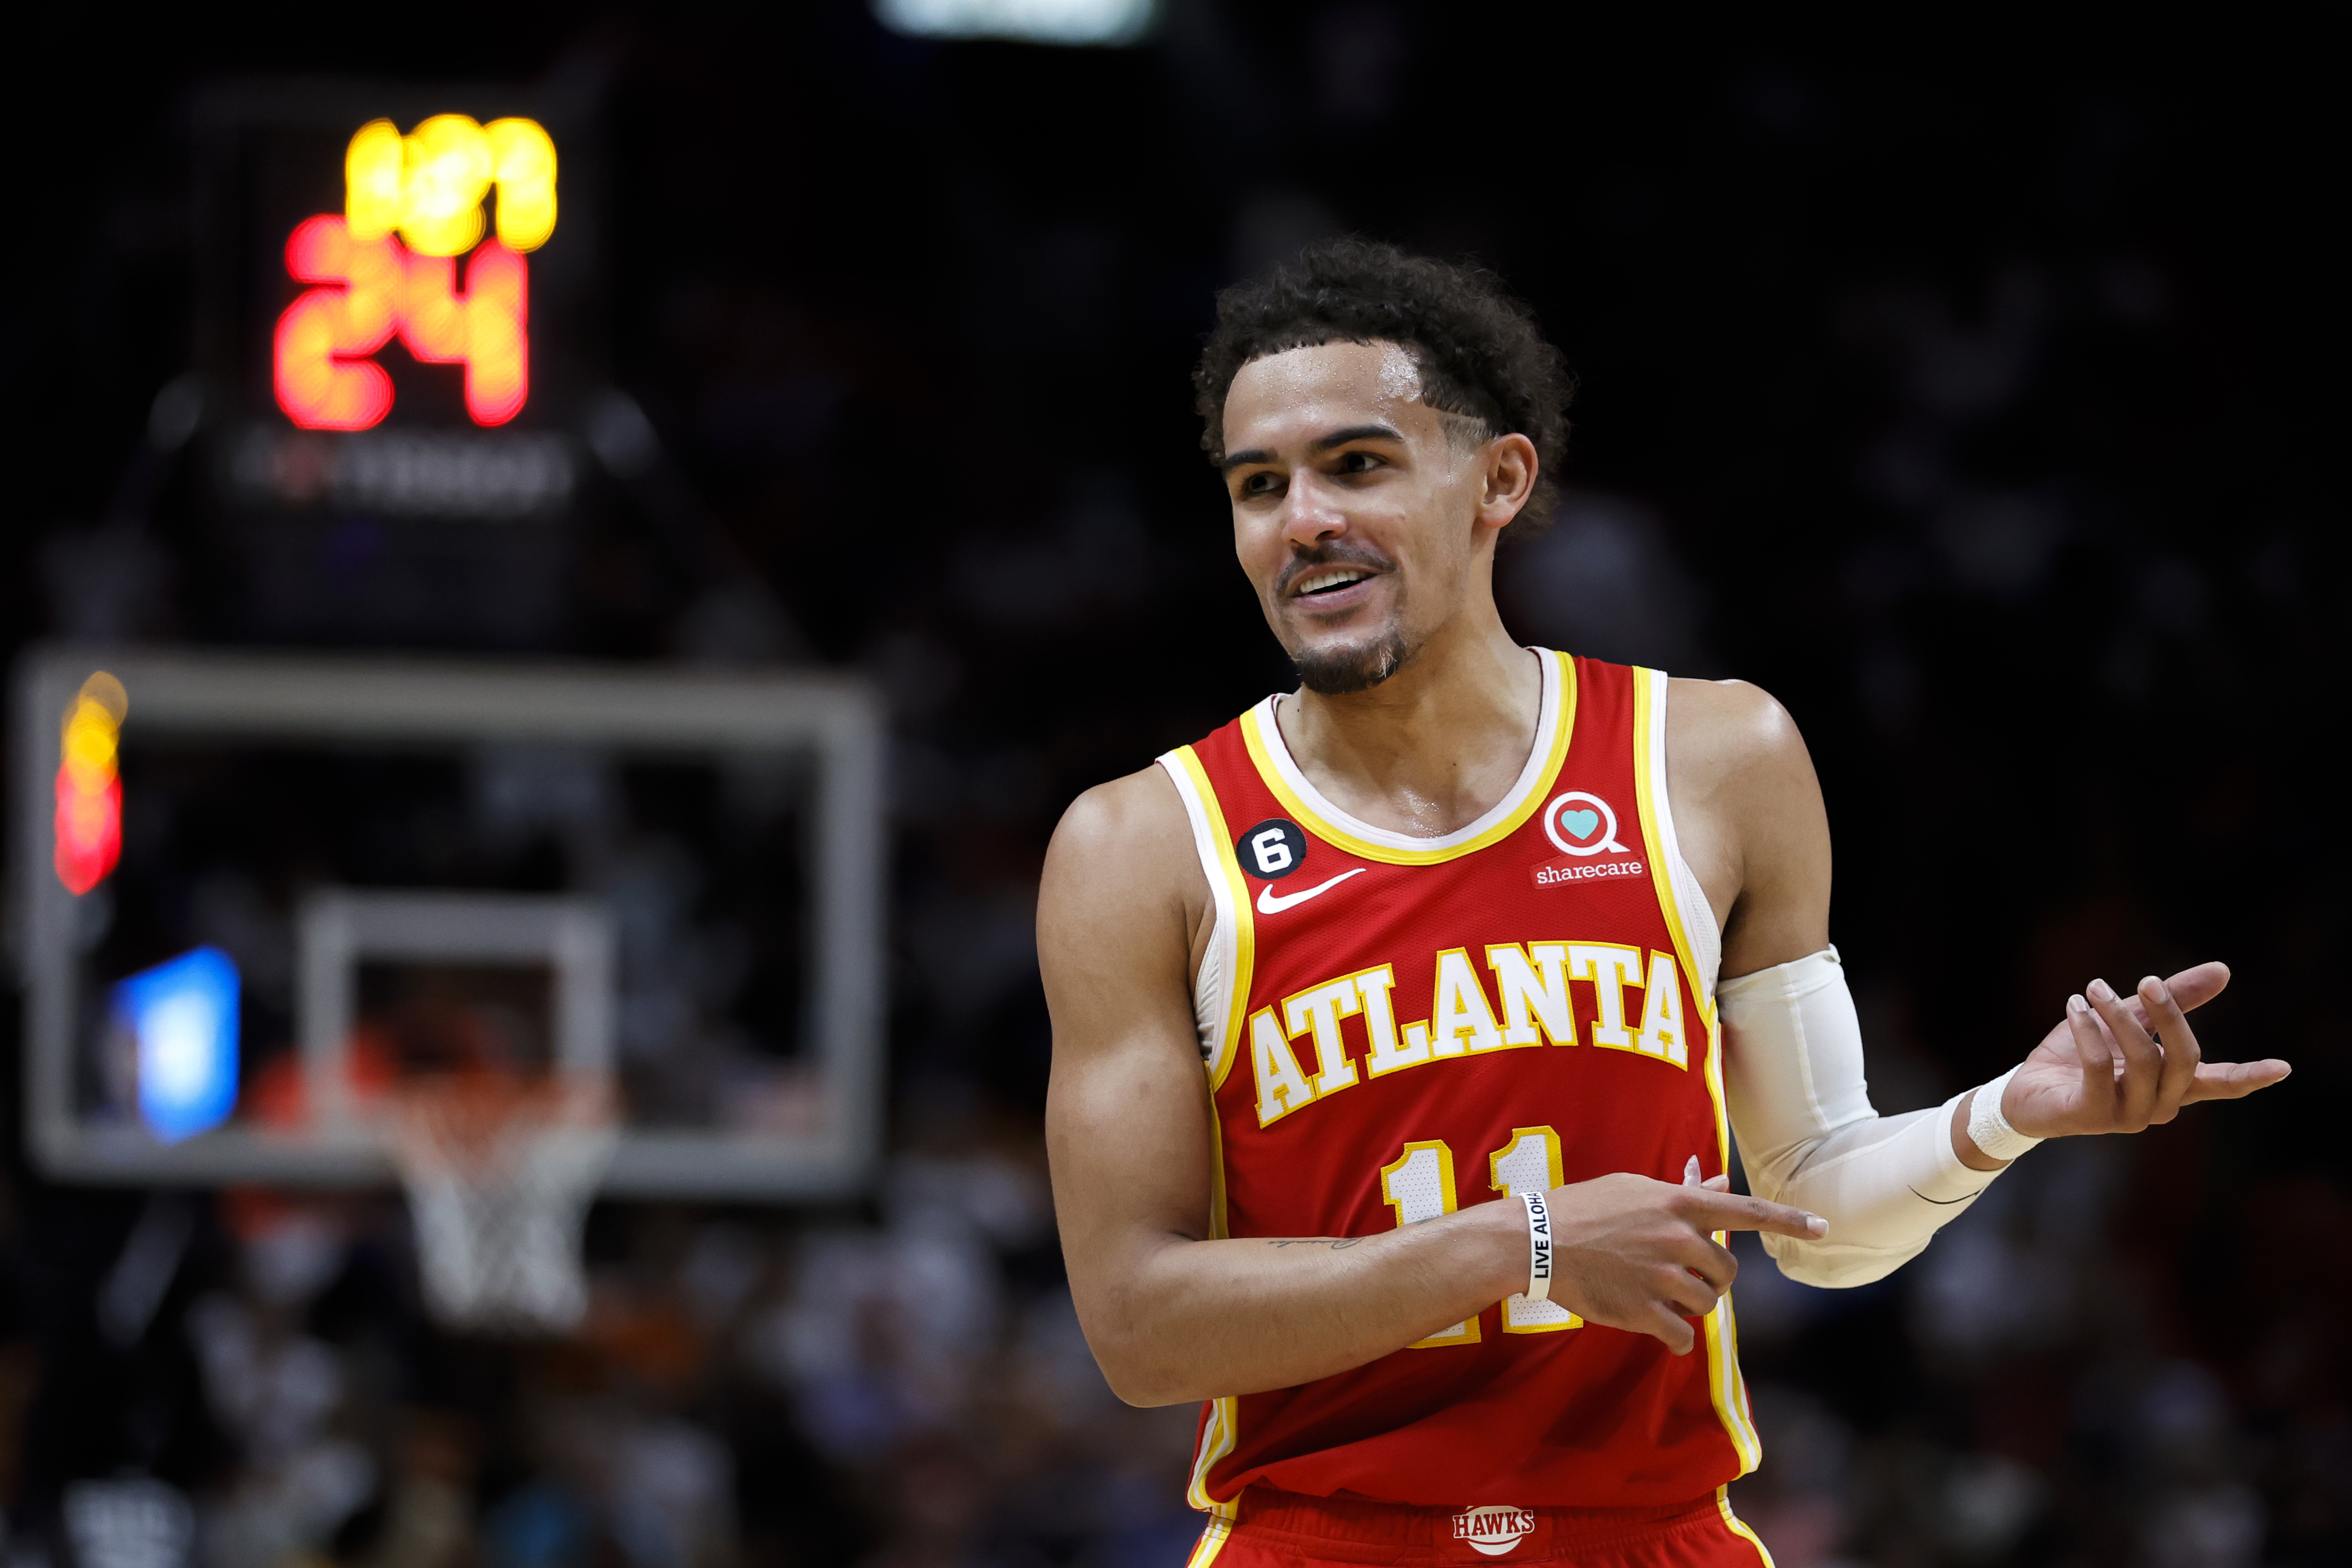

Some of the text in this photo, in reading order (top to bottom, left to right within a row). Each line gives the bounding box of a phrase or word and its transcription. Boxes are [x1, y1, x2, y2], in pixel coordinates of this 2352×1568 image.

[274, 213, 528, 431] 24
[1251, 828, 1293, 873] 6
[1537, 862, 1643, 884] sharecare
[1249, 941, 1688, 1129] ATLANTA
[1526, 1192, 1549, 1278] LIVE ALOHA
[1453, 1510, 1535, 1538] HAWKS
